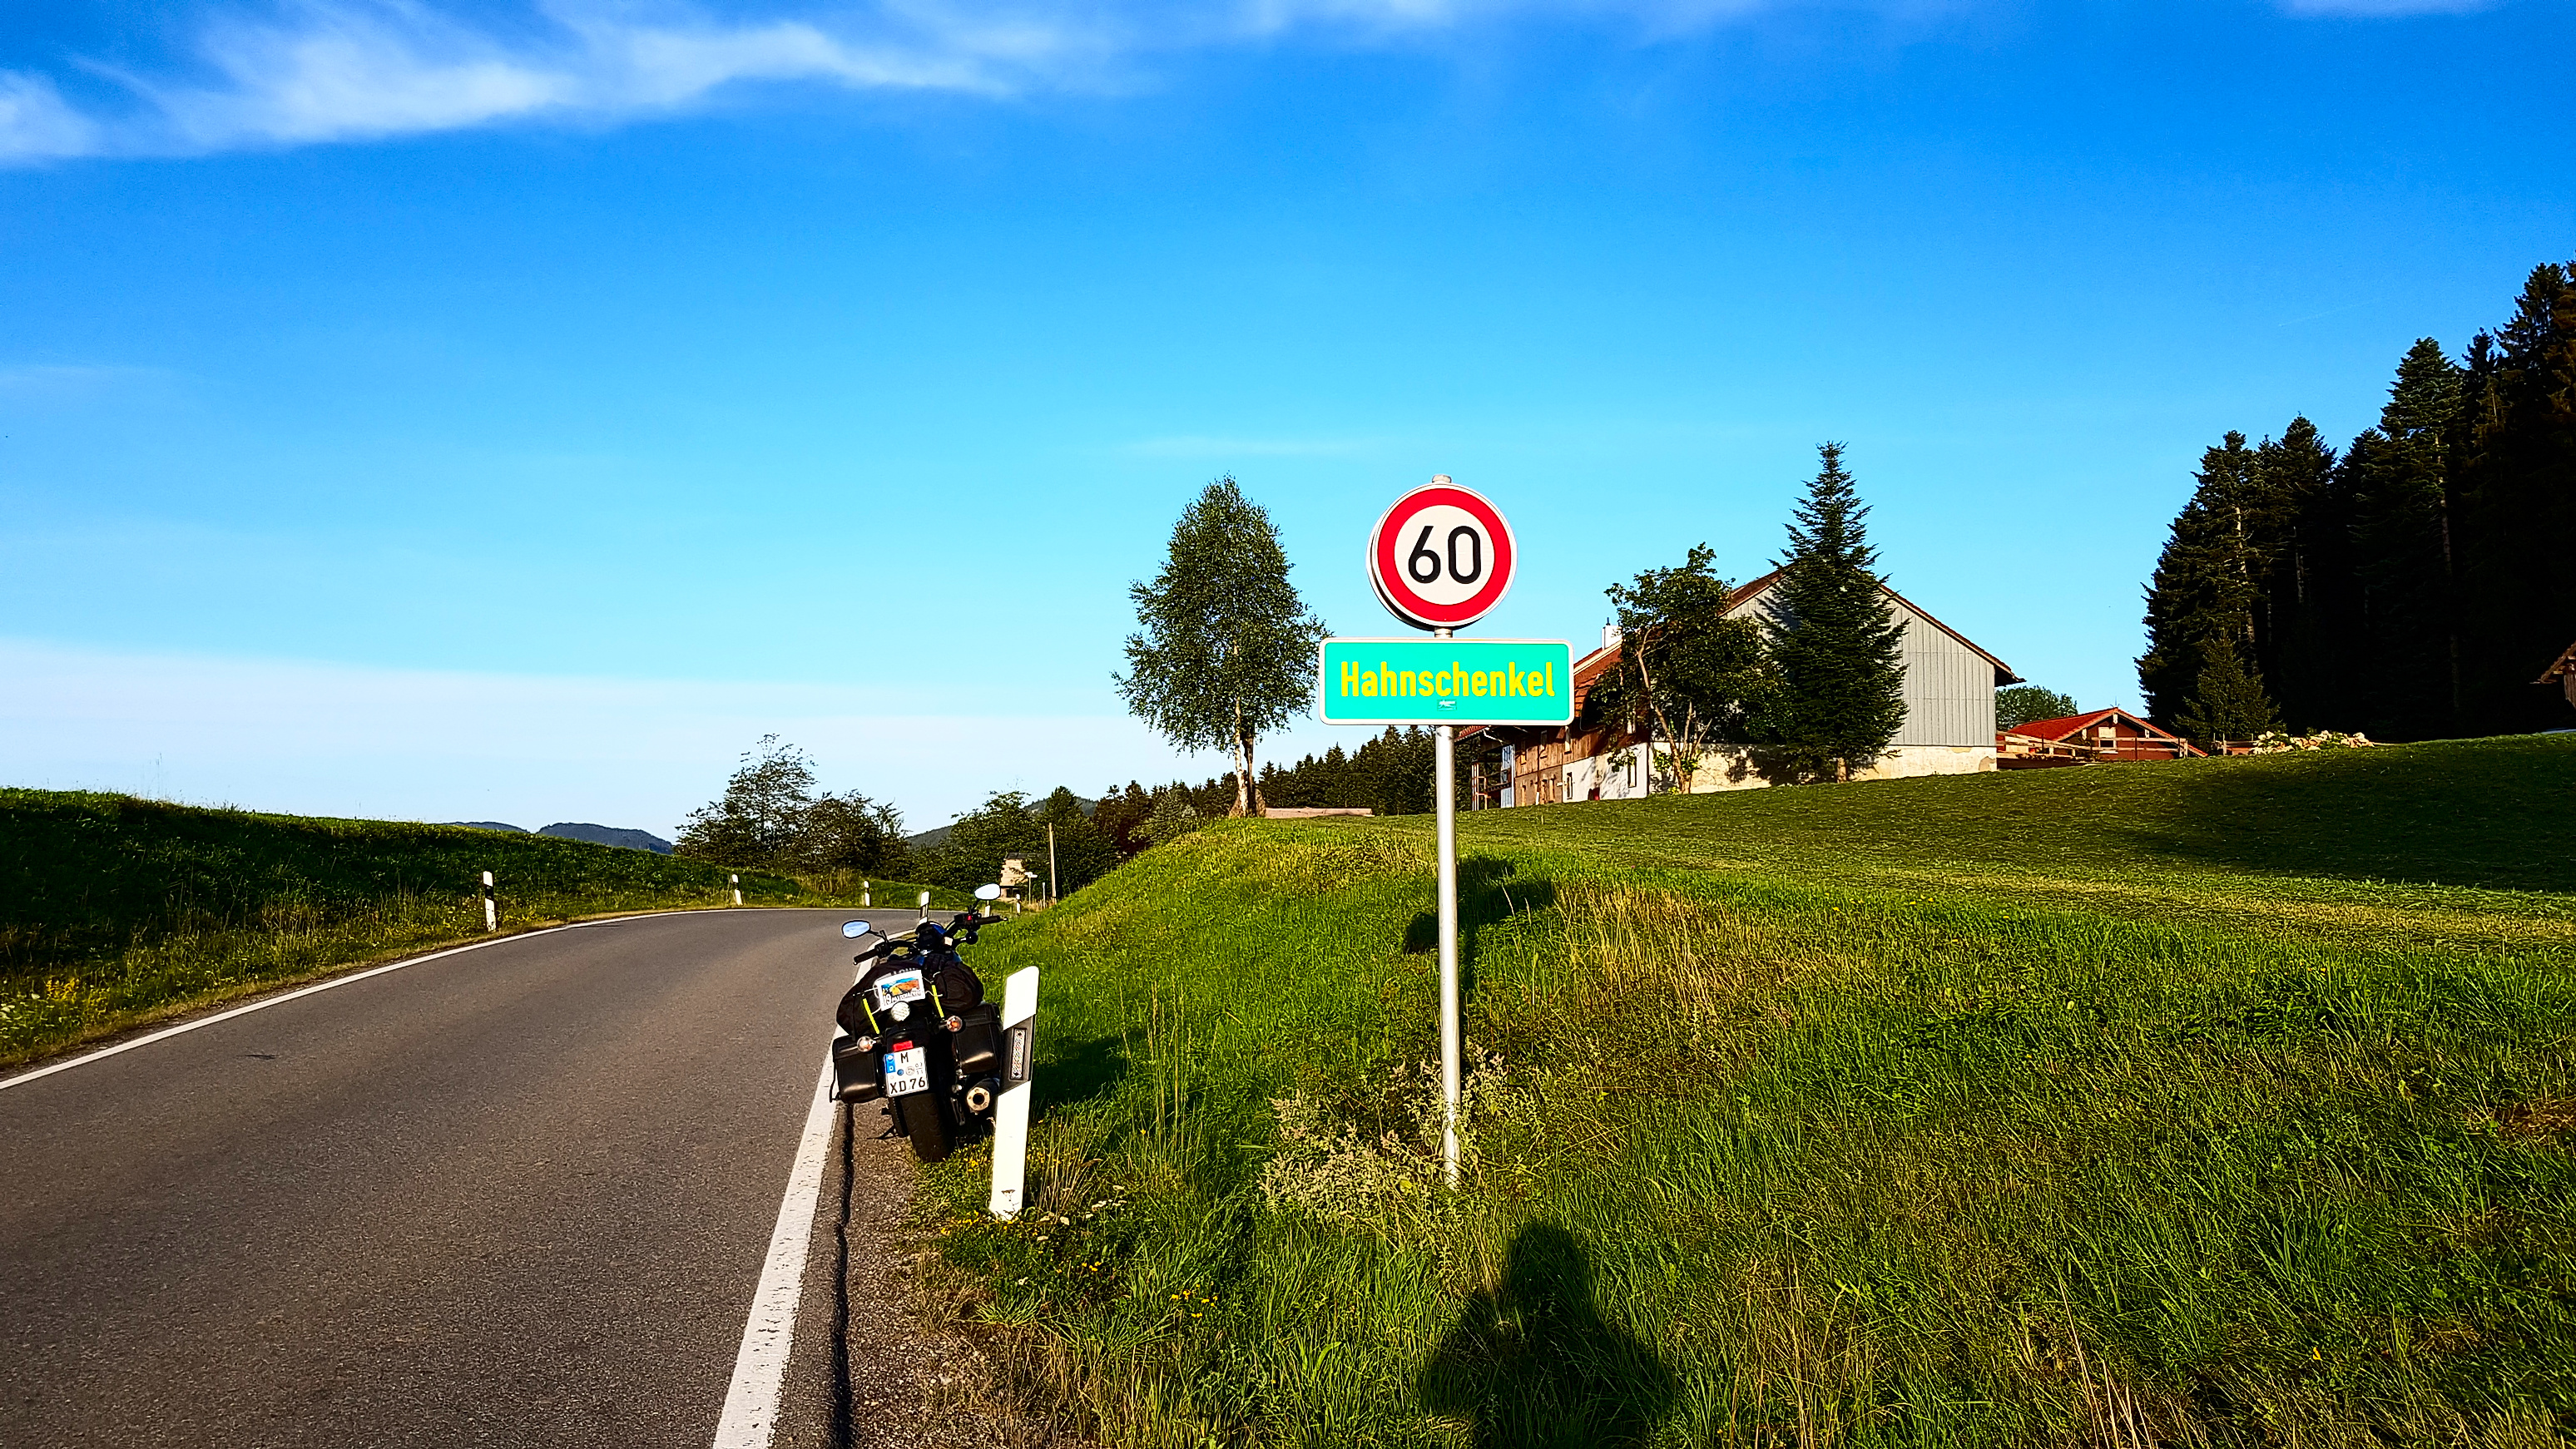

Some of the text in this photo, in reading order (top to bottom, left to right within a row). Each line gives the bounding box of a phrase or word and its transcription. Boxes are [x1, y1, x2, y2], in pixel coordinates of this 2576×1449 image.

[1408, 525, 1482, 585] 60
[1340, 660, 1556, 698] Hahnschenkel
[900, 1051, 909, 1064] M
[889, 1076, 926, 1095] XD 76
